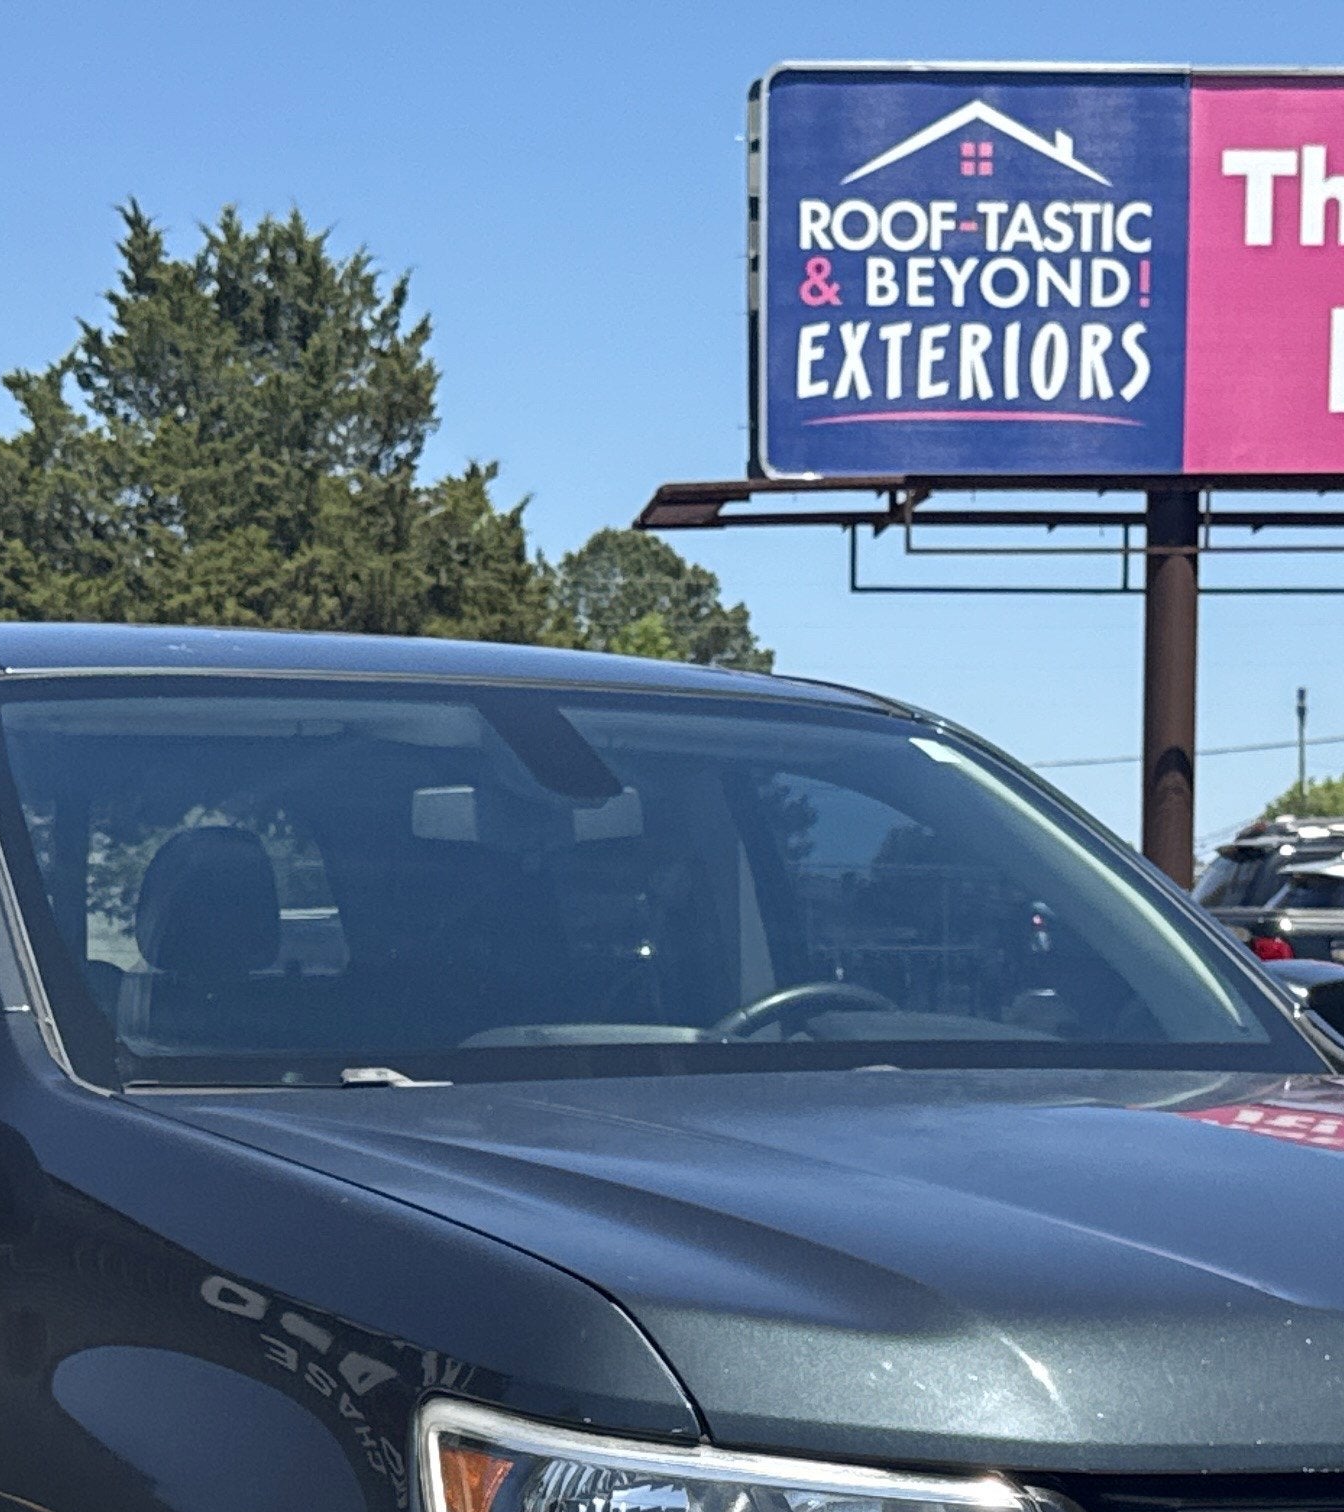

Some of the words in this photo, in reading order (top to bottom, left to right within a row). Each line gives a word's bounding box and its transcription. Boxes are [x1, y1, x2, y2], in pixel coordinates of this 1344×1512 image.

[799, 199, 1153, 253] ROOF-TASTIC
[799, 255, 843, 307] &
[865, 255, 1152, 309] BEYOND!
[796, 320, 1152, 403] EXTERIORS
